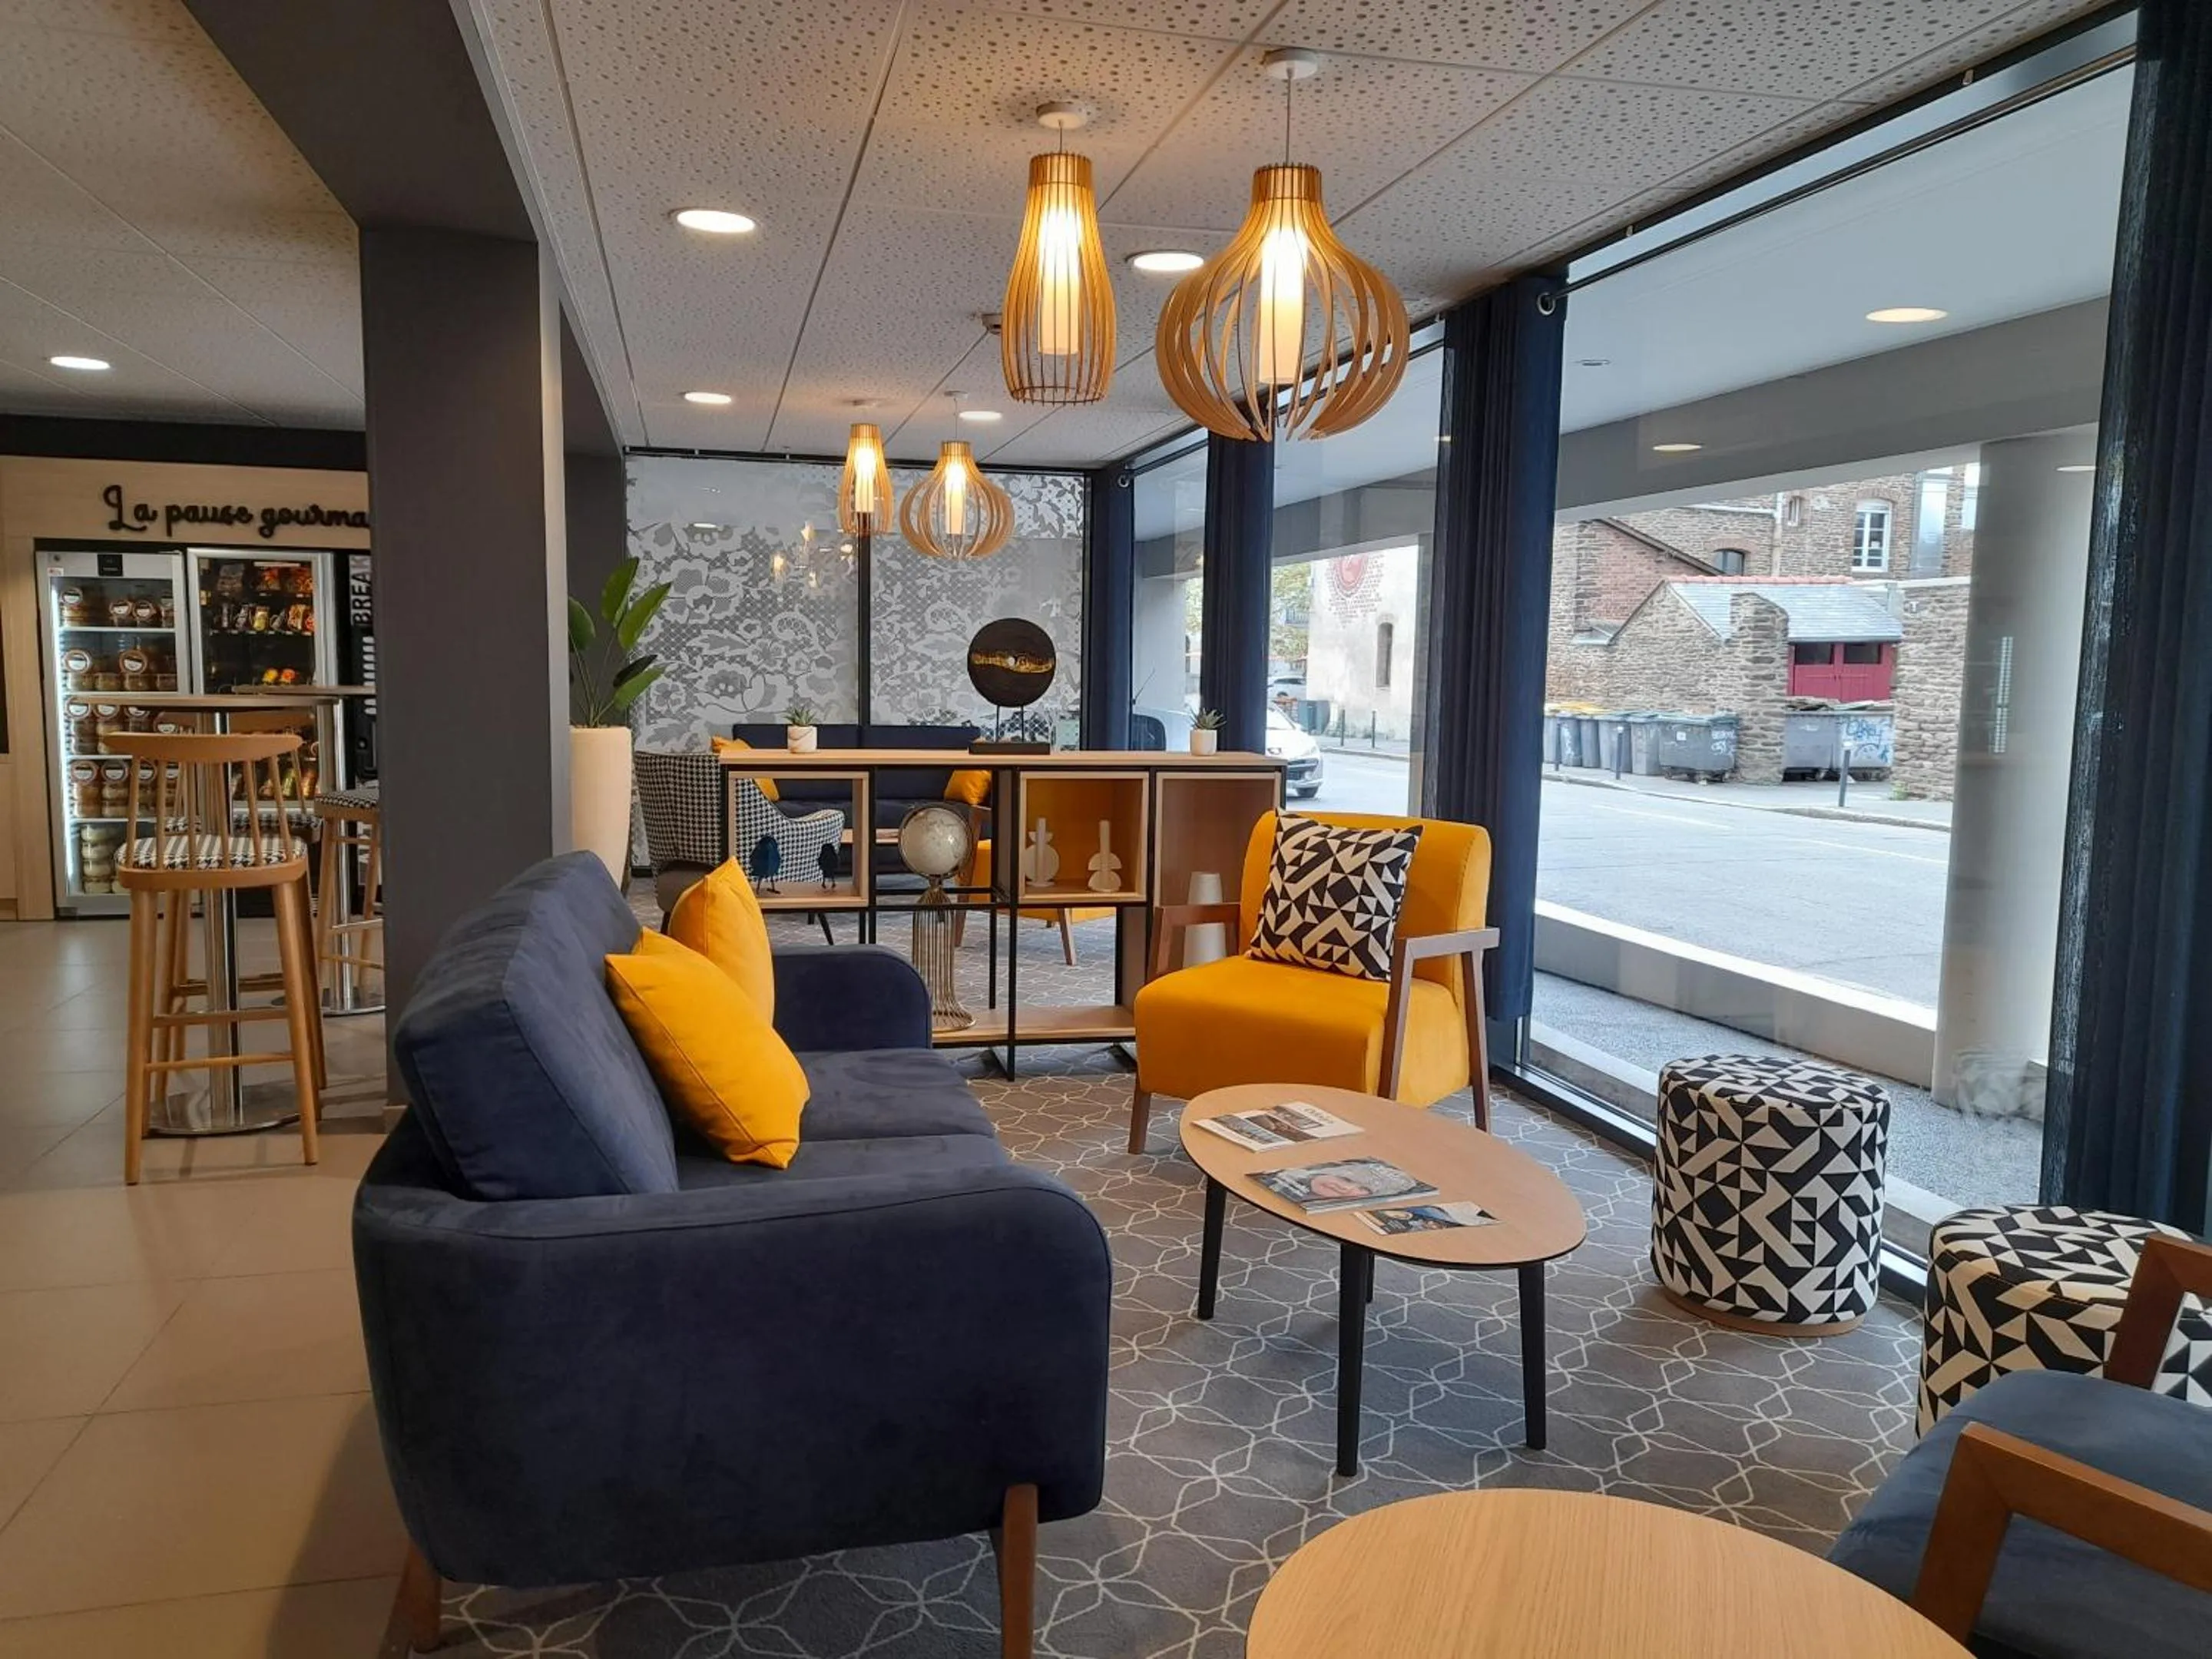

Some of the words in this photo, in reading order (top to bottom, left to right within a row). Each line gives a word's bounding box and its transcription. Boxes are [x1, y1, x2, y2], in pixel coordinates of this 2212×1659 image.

[102, 484, 158, 532] La
[164, 503, 254, 538] pause
[257, 503, 372, 539] gourma
[350, 555, 373, 626] BREAK
